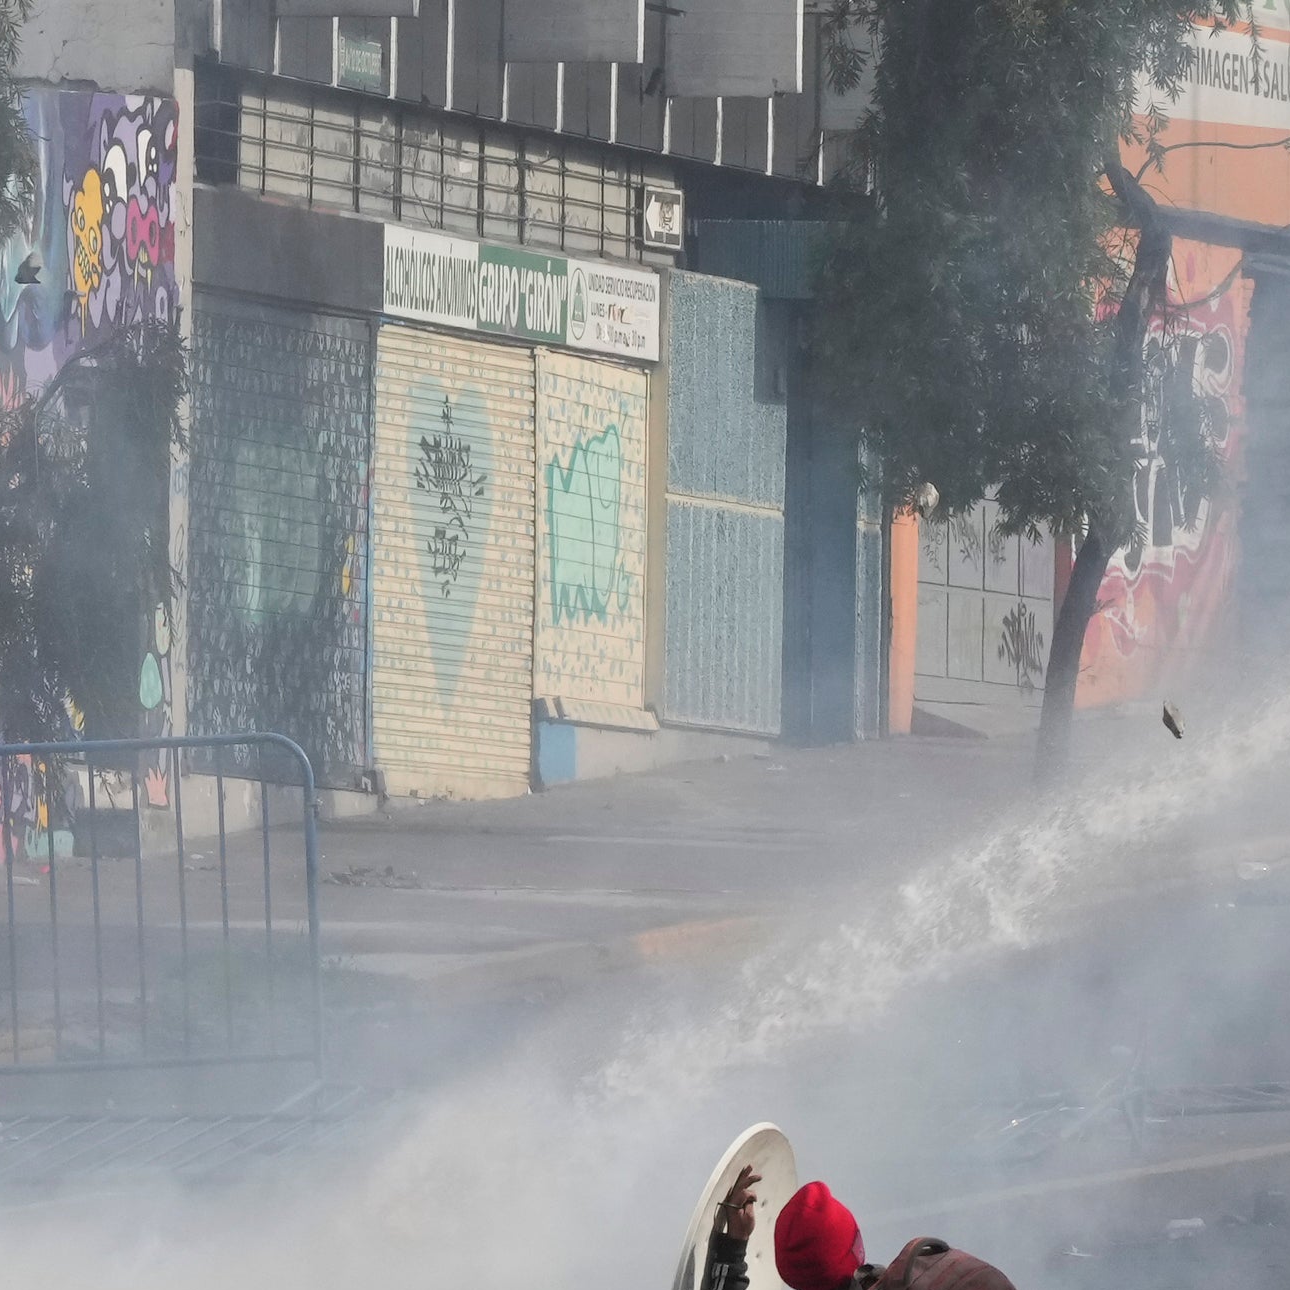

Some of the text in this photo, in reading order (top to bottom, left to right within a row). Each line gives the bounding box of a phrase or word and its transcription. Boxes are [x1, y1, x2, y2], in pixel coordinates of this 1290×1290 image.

[1196, 46, 1249, 94] IMAGEN
[385, 236, 477, 320] ALCOHÓLICOS ANÓNIMOS
[479, 262, 519, 328] GRUPO
[588, 273, 605, 292] UNIDAD
